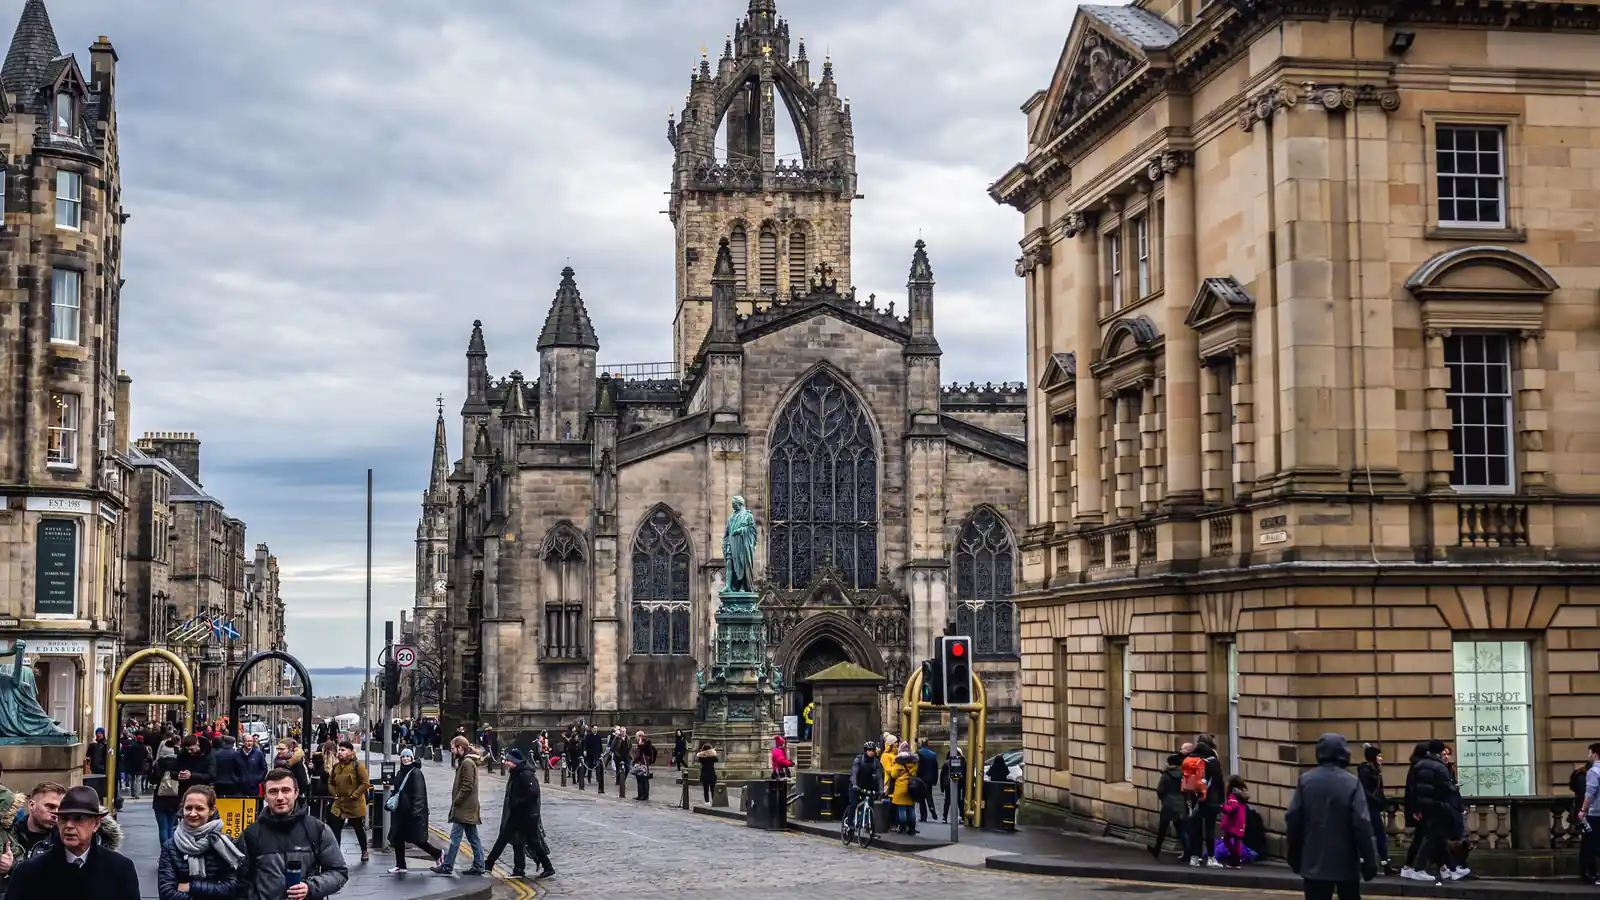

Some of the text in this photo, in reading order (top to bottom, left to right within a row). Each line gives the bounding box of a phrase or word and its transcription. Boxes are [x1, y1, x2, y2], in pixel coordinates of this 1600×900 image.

[398, 652, 412, 662] 20
[1469, 692, 1520, 702] BISTROT
[1461, 725, 1510, 733] ENTRANCE
